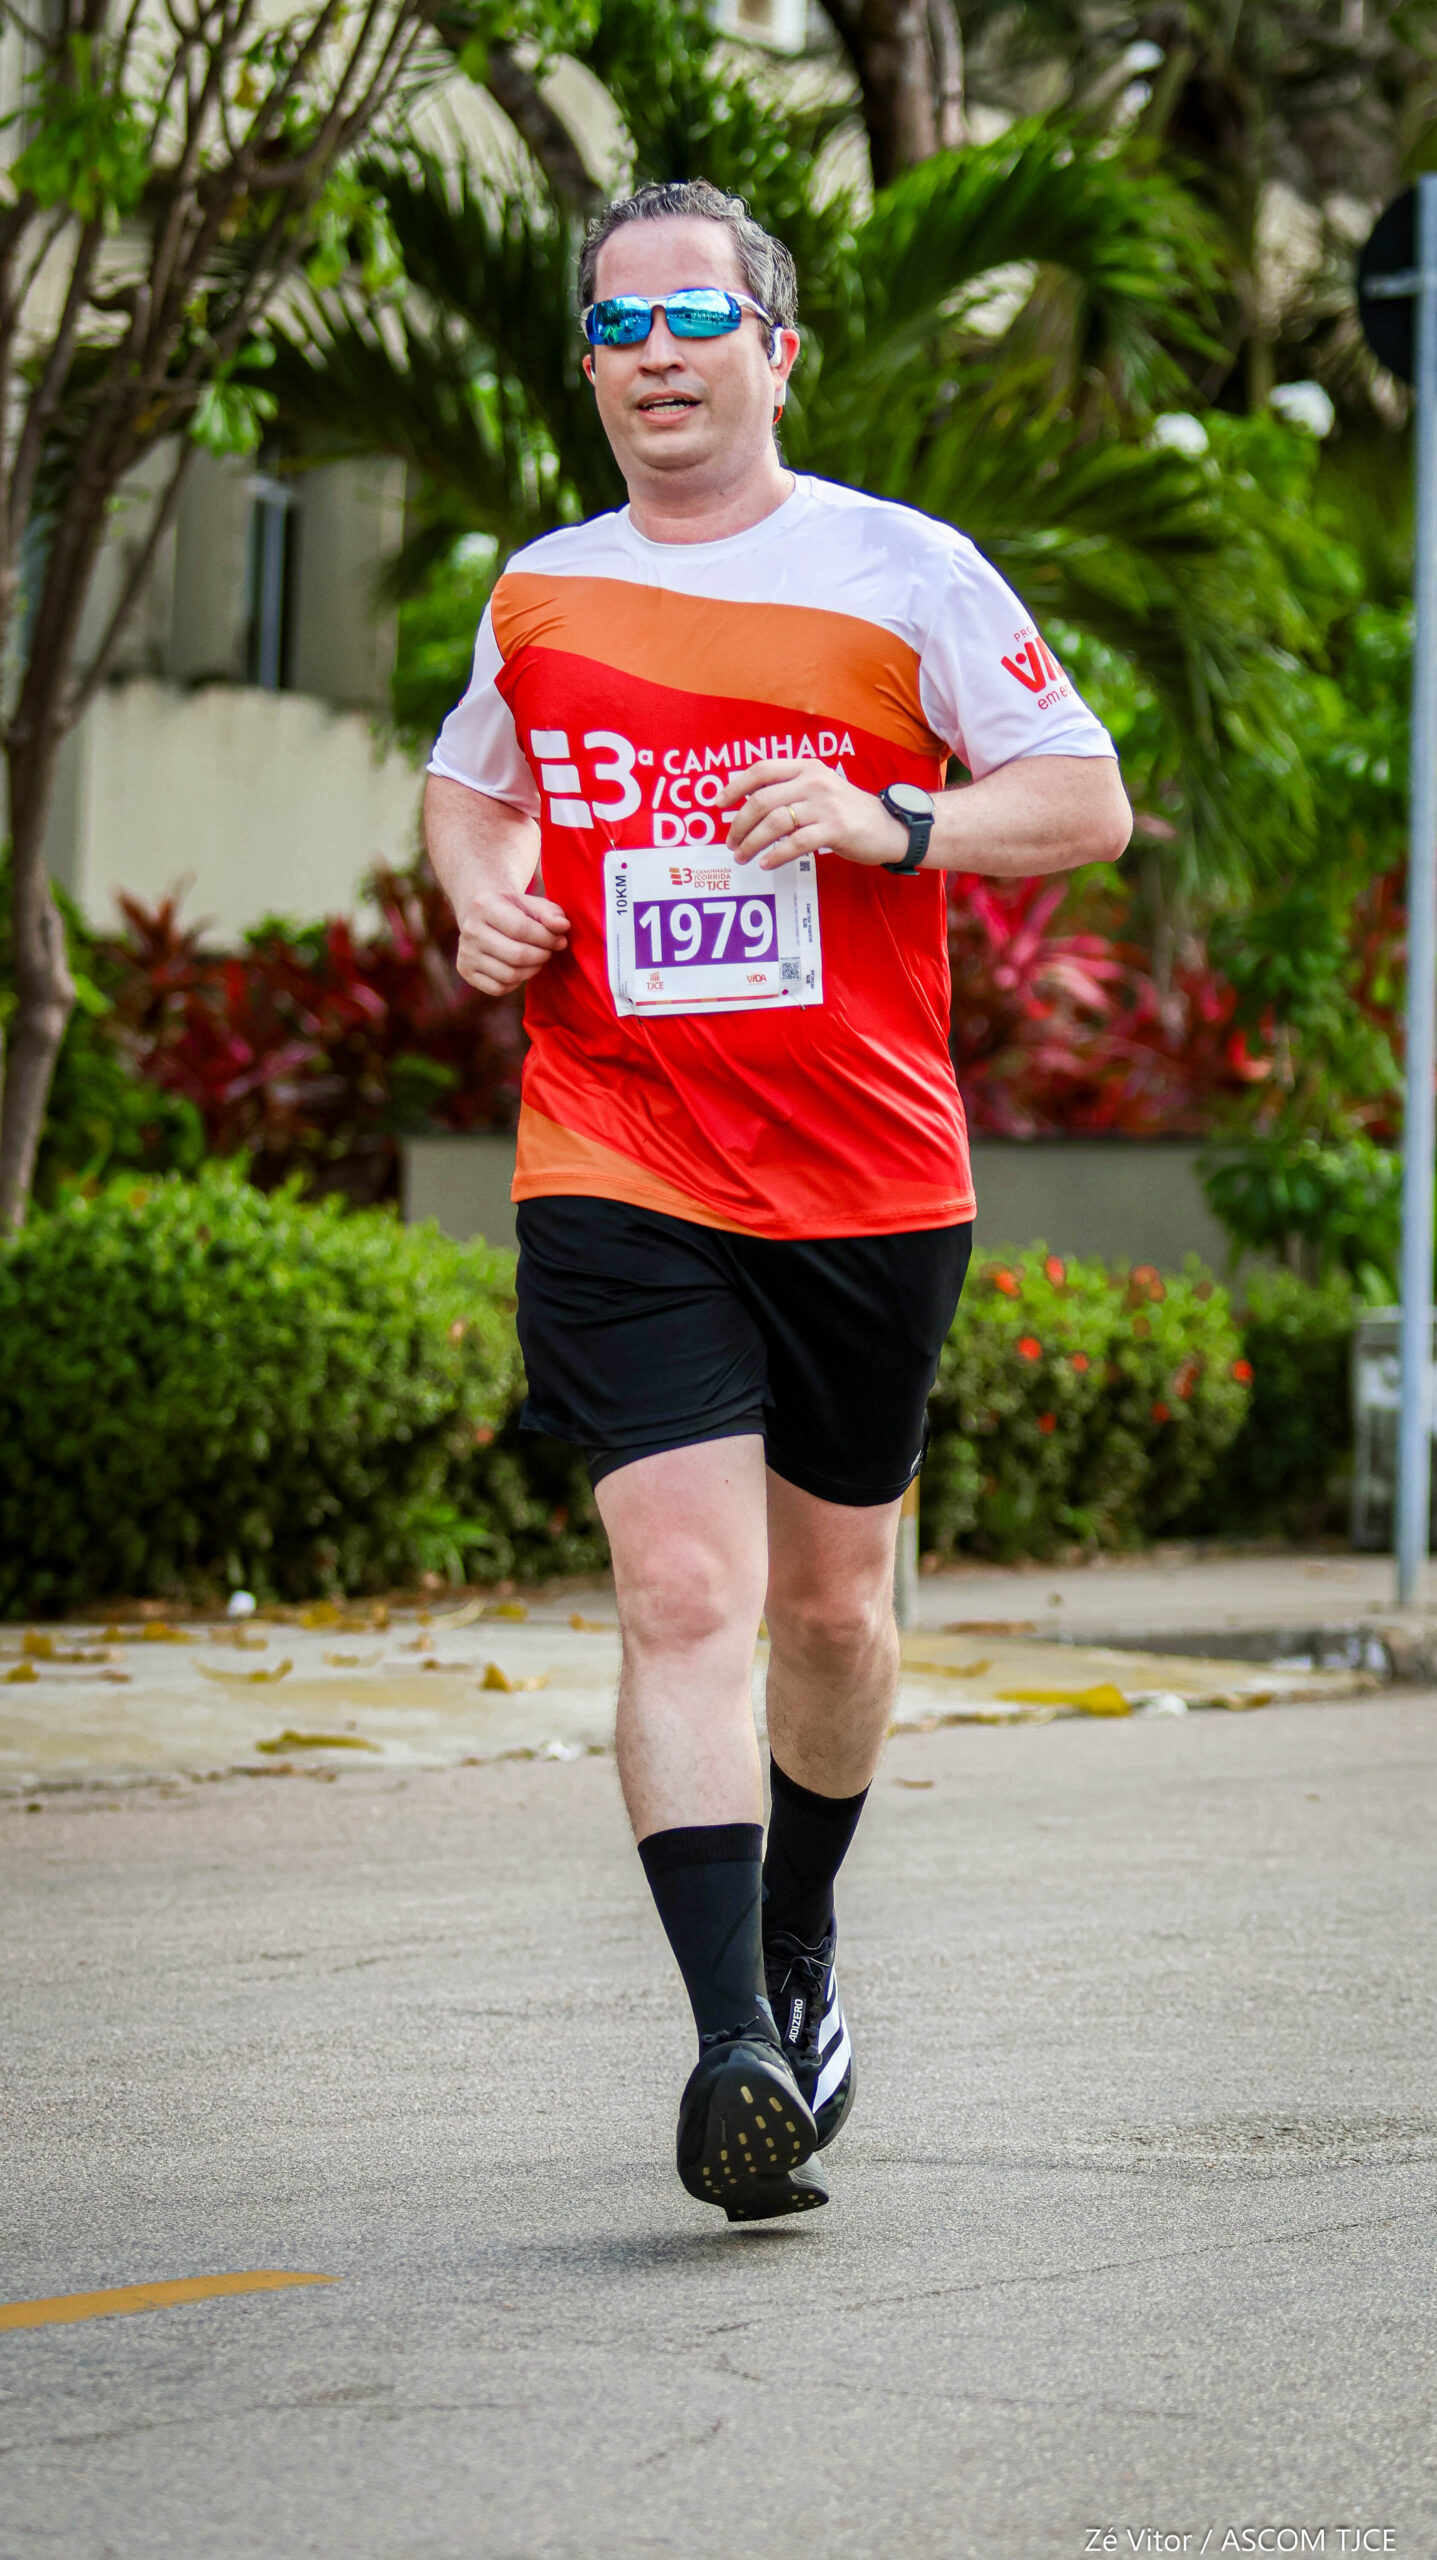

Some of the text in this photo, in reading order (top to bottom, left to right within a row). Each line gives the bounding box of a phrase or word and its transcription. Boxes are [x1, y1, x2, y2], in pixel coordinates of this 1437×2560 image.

[1013, 626, 1034, 642] PRO
[1037, 690, 1061, 710] em
[663, 731, 856, 775] CAMINHADA
[653, 811, 716, 848] DO
[615, 875, 628, 916] 10KM
[694, 880, 730, 891] DO TJCE
[639, 899, 774, 962] 1979
[646, 981, 664, 991] TJCE
[789, 1998, 804, 2043] ADIZERO
